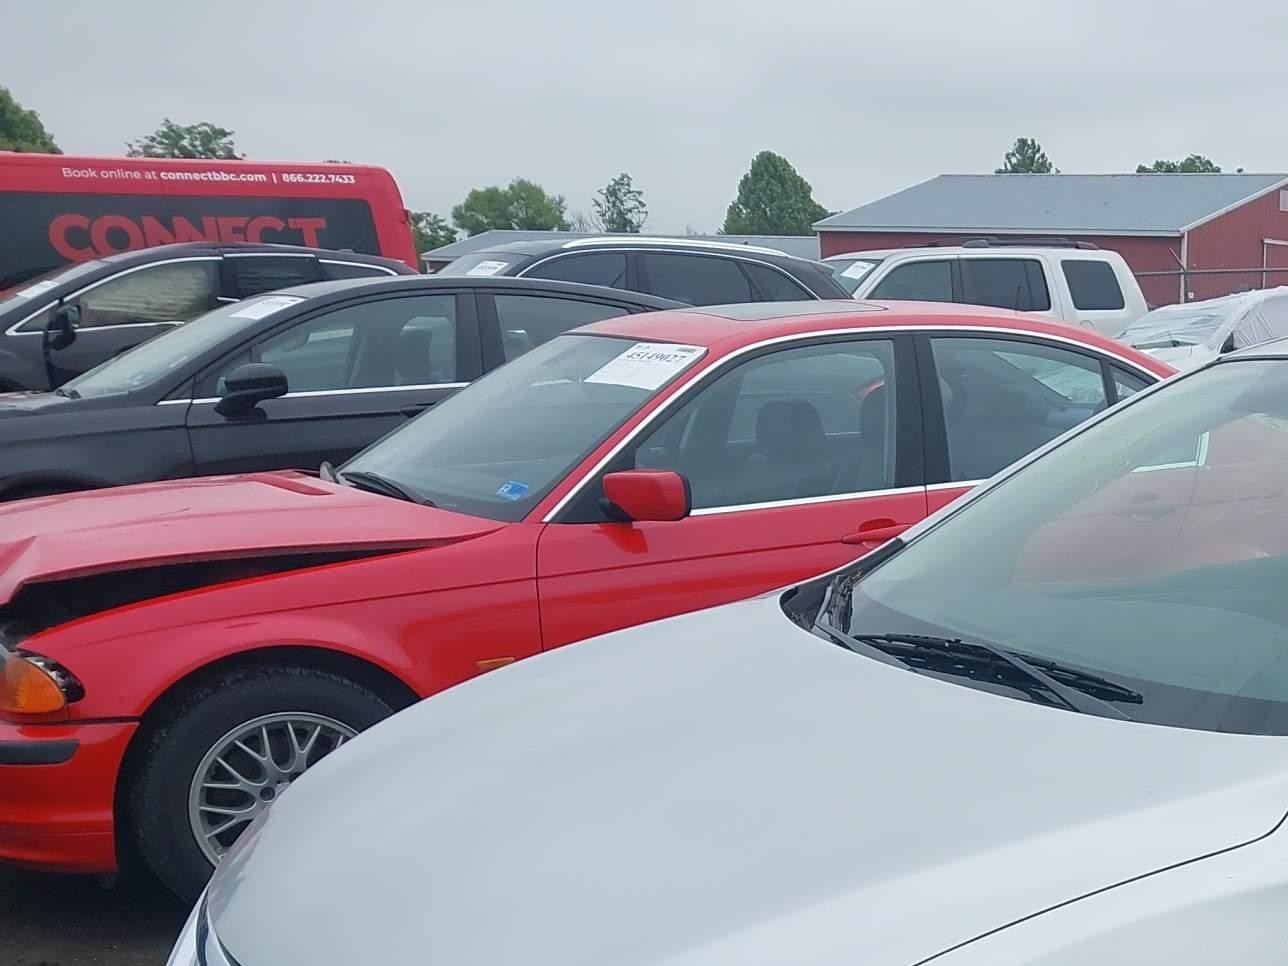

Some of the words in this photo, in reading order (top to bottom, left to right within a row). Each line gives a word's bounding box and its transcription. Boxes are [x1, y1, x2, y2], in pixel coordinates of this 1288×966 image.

[62, 167, 98, 178] Book
[100, 168, 141, 179] online
[144, 172, 158, 180] at
[160, 171, 267, 182] connectbbc.com
[282, 173, 356, 184] 866.222.7433
